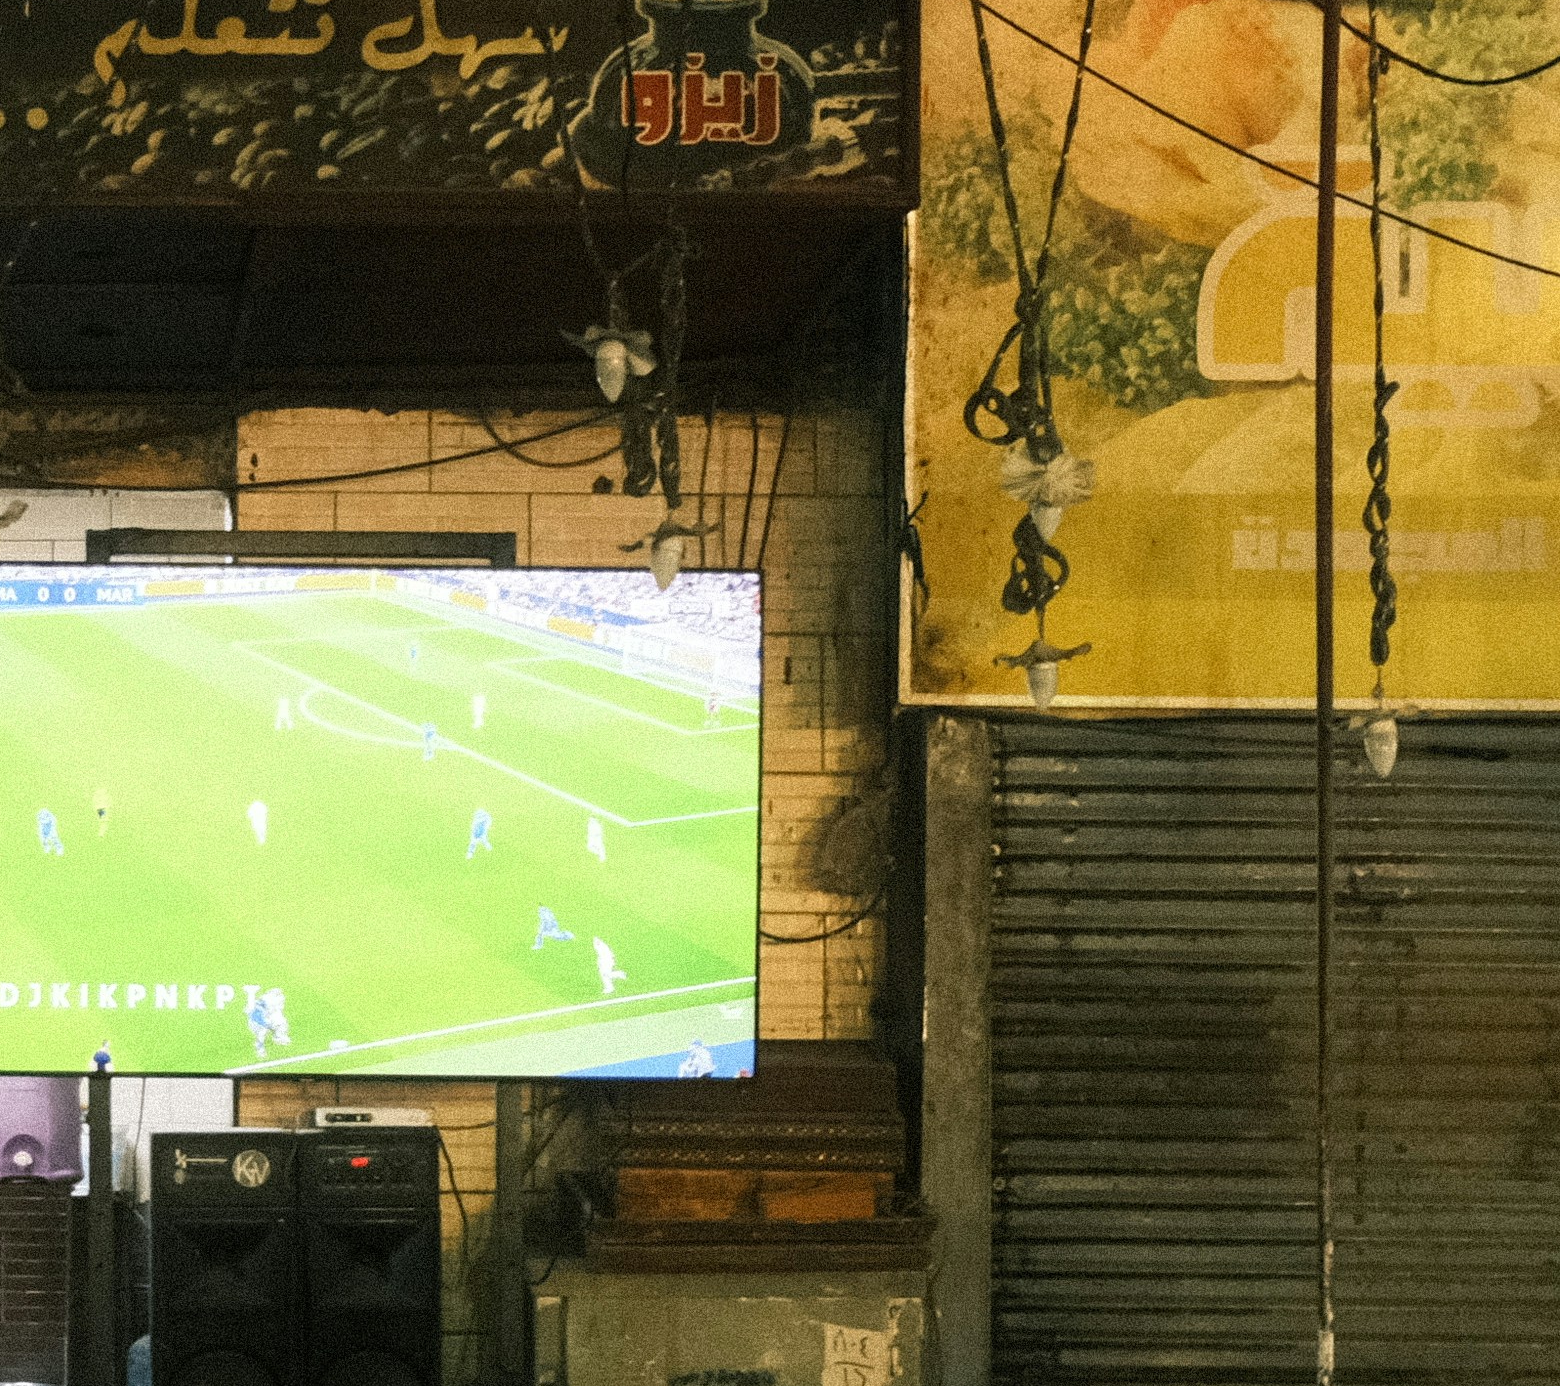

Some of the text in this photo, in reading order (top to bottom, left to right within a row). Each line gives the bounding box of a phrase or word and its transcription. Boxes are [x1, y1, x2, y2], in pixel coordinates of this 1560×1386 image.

[621, 52, 780, 145] زيزو
[37, 586, 50, 602] 0
[63, 586, 77, 602] 0
[96, 588, 134, 602] MAR
